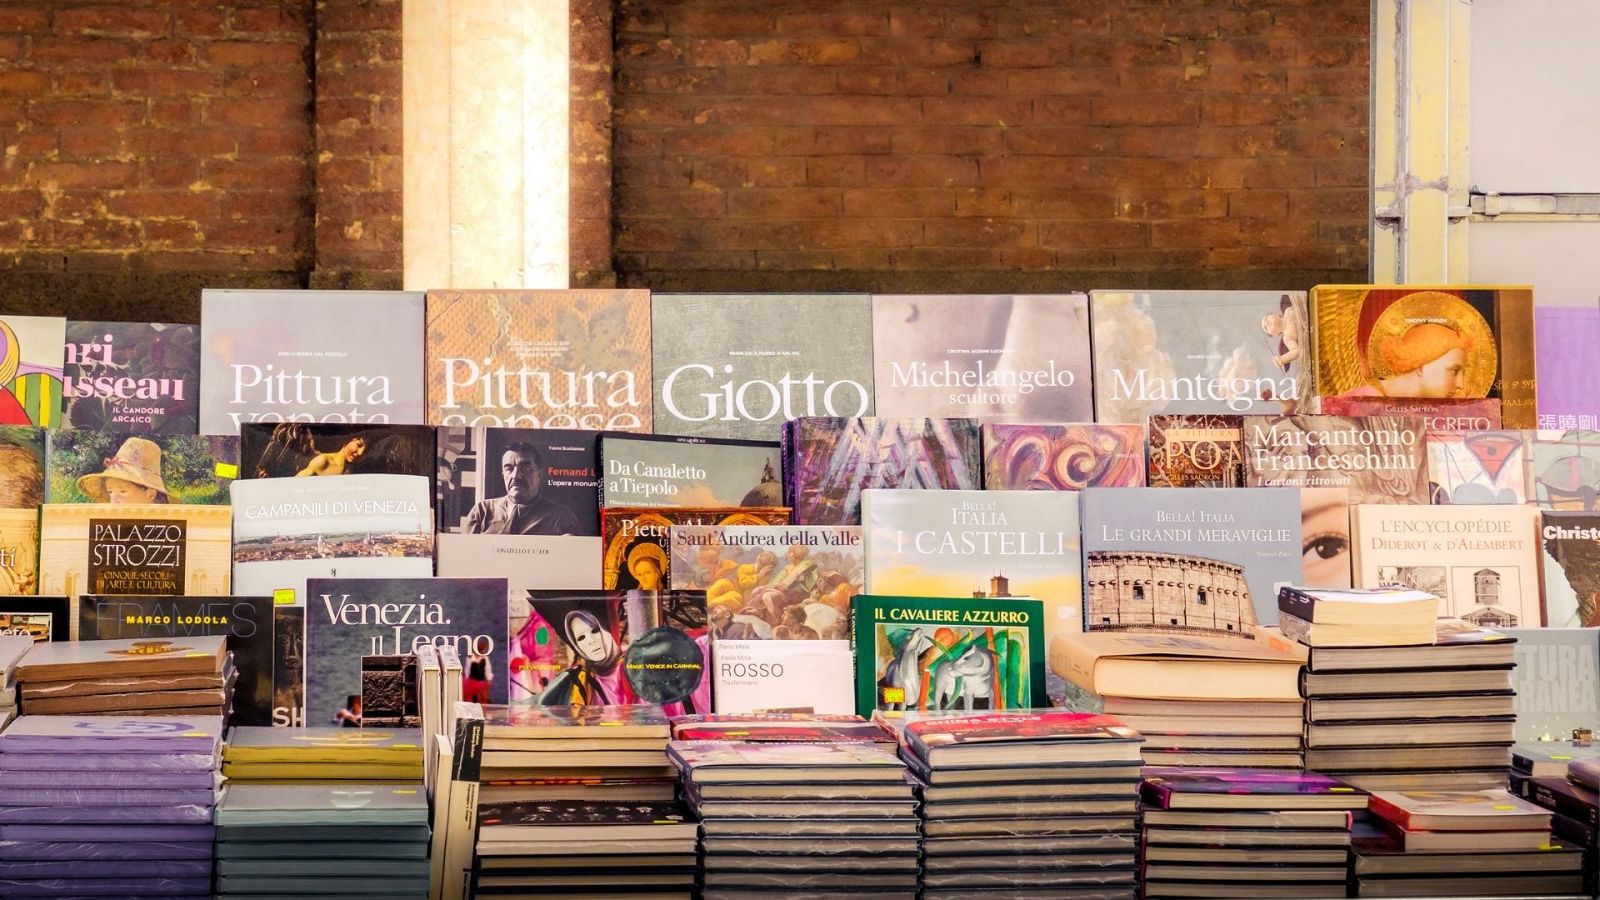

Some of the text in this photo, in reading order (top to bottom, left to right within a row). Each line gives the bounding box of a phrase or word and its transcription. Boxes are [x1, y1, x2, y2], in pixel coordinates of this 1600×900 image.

[229, 363, 395, 405] Pittura
[440, 357, 641, 409] Pittura
[890, 359, 1074, 393] Michelangelo
[662, 363, 869, 422] Giotto
[948, 388, 1017, 405] scultore
[1110, 368, 1300, 411] Mantegna
[123, 407, 165, 415] CANDORE
[1254, 424, 1416, 448] Marcantonio
[1254, 446, 1416, 471] Franceschini
[548, 466, 588, 477] Fernand
[609, 459, 706, 480] Da Canaletto
[609, 481, 618, 493] a
[620, 478, 678, 497] Tiepolo
[1267, 477, 1303, 487] cartoni
[1305, 475, 1352, 486] ritrovati
[245, 500, 418, 520] CAMPANILI DI VENEZIA
[952, 508, 1007, 526] ITALIA
[1200, 510, 1234, 522] ITALIA
[95, 524, 182, 543] PALAZZO
[1382, 518, 1512, 533] L'ENCYCLOPÉDIE
[677, 530, 859, 546] Sant'Andrea della Valle
[897, 530, 1065, 555] I CASTELLI
[1371, 537, 1428, 550] DIDEROT
[93, 544, 180, 568] STROZZI
[104, 571, 138, 580] CINQUE
[106, 580, 127, 588] ARTE
[136, 580, 176, 589] CULTURA
[320, 594, 451, 625] Venezia.
[875, 608, 1029, 623] IL CAVALIERE AZZURRO
[96, 602, 257, 638] FRAMES
[127, 615, 227, 625] MARCO LODOLA
[721, 663, 784, 677] ROSSO
